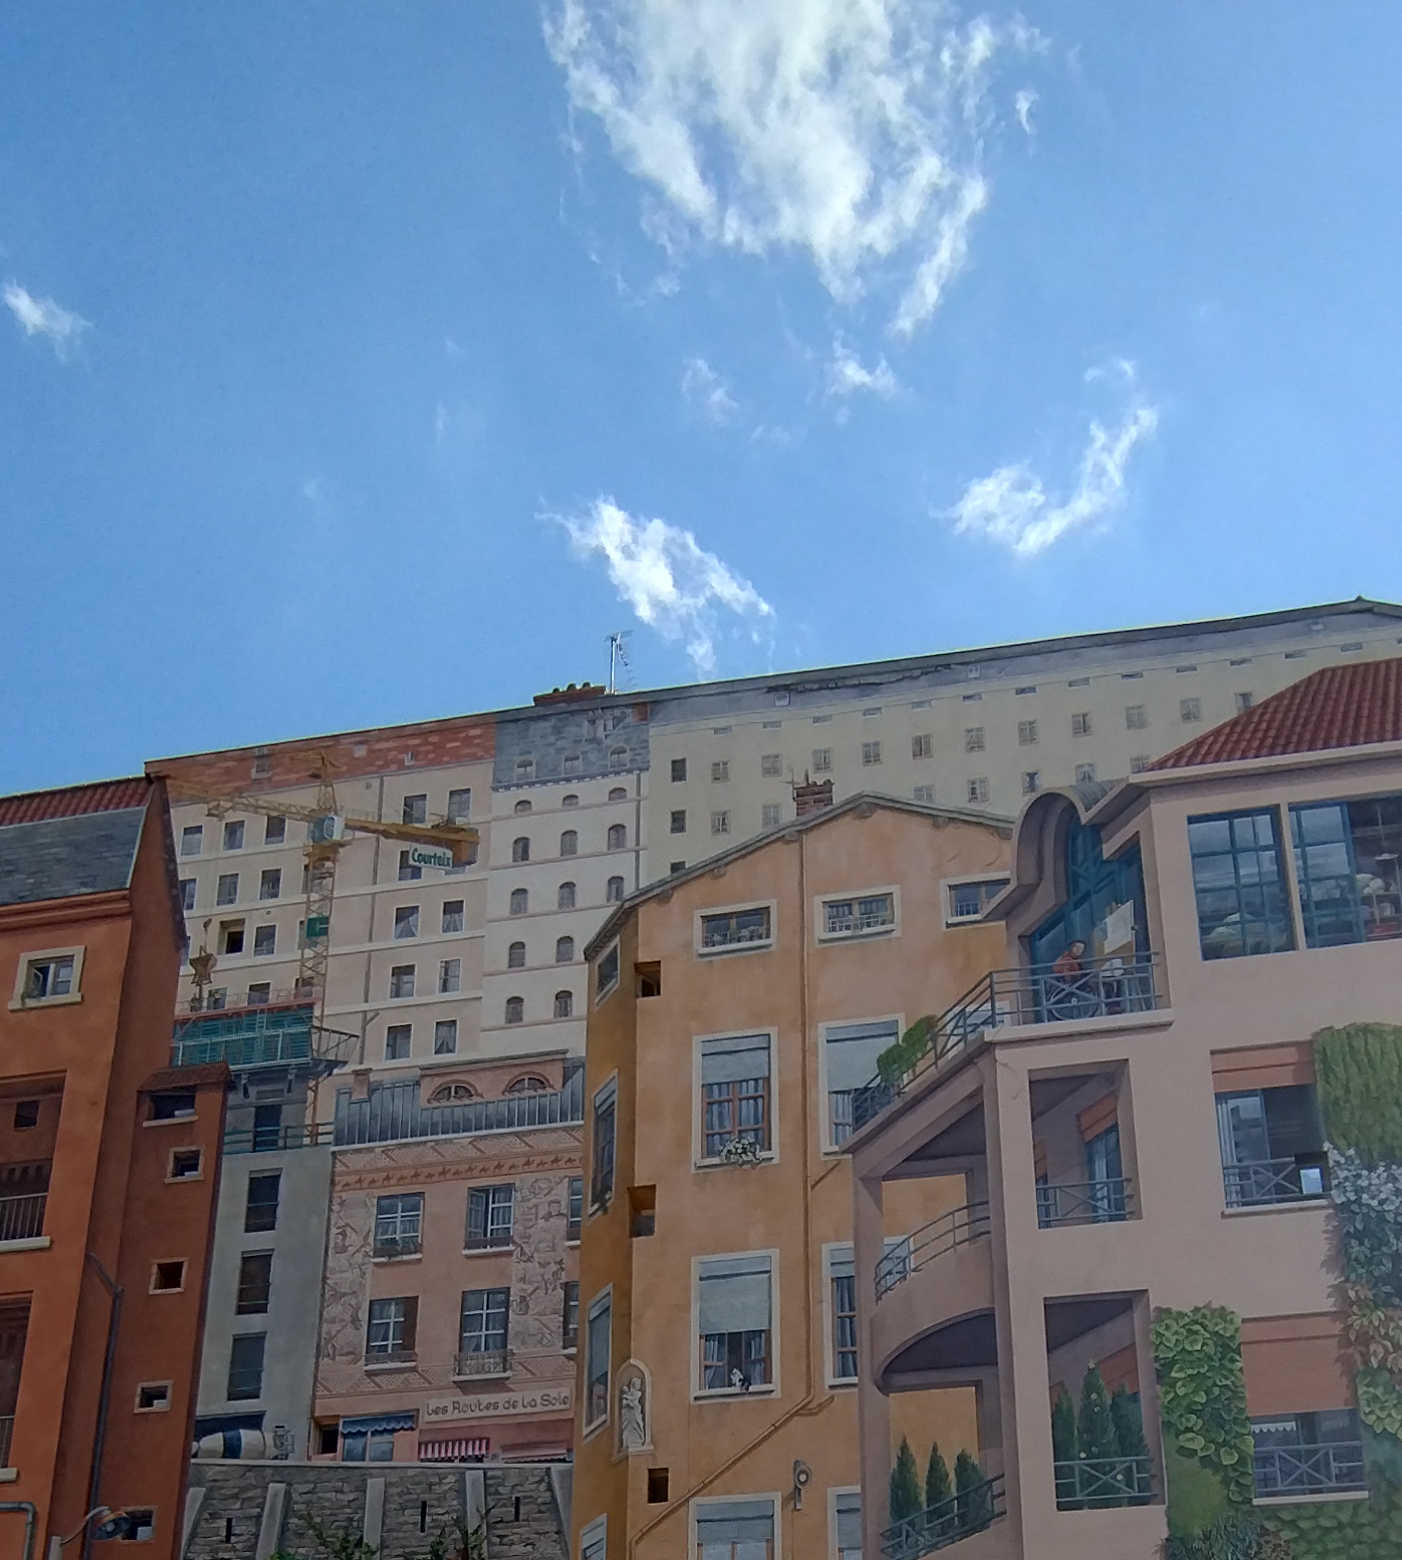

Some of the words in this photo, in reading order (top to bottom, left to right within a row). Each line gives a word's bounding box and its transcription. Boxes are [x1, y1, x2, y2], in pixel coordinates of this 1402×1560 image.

[451, 1399, 500, 1415] Routes
[502, 1397, 518, 1411] de
[539, 1391, 571, 1407] Soie
